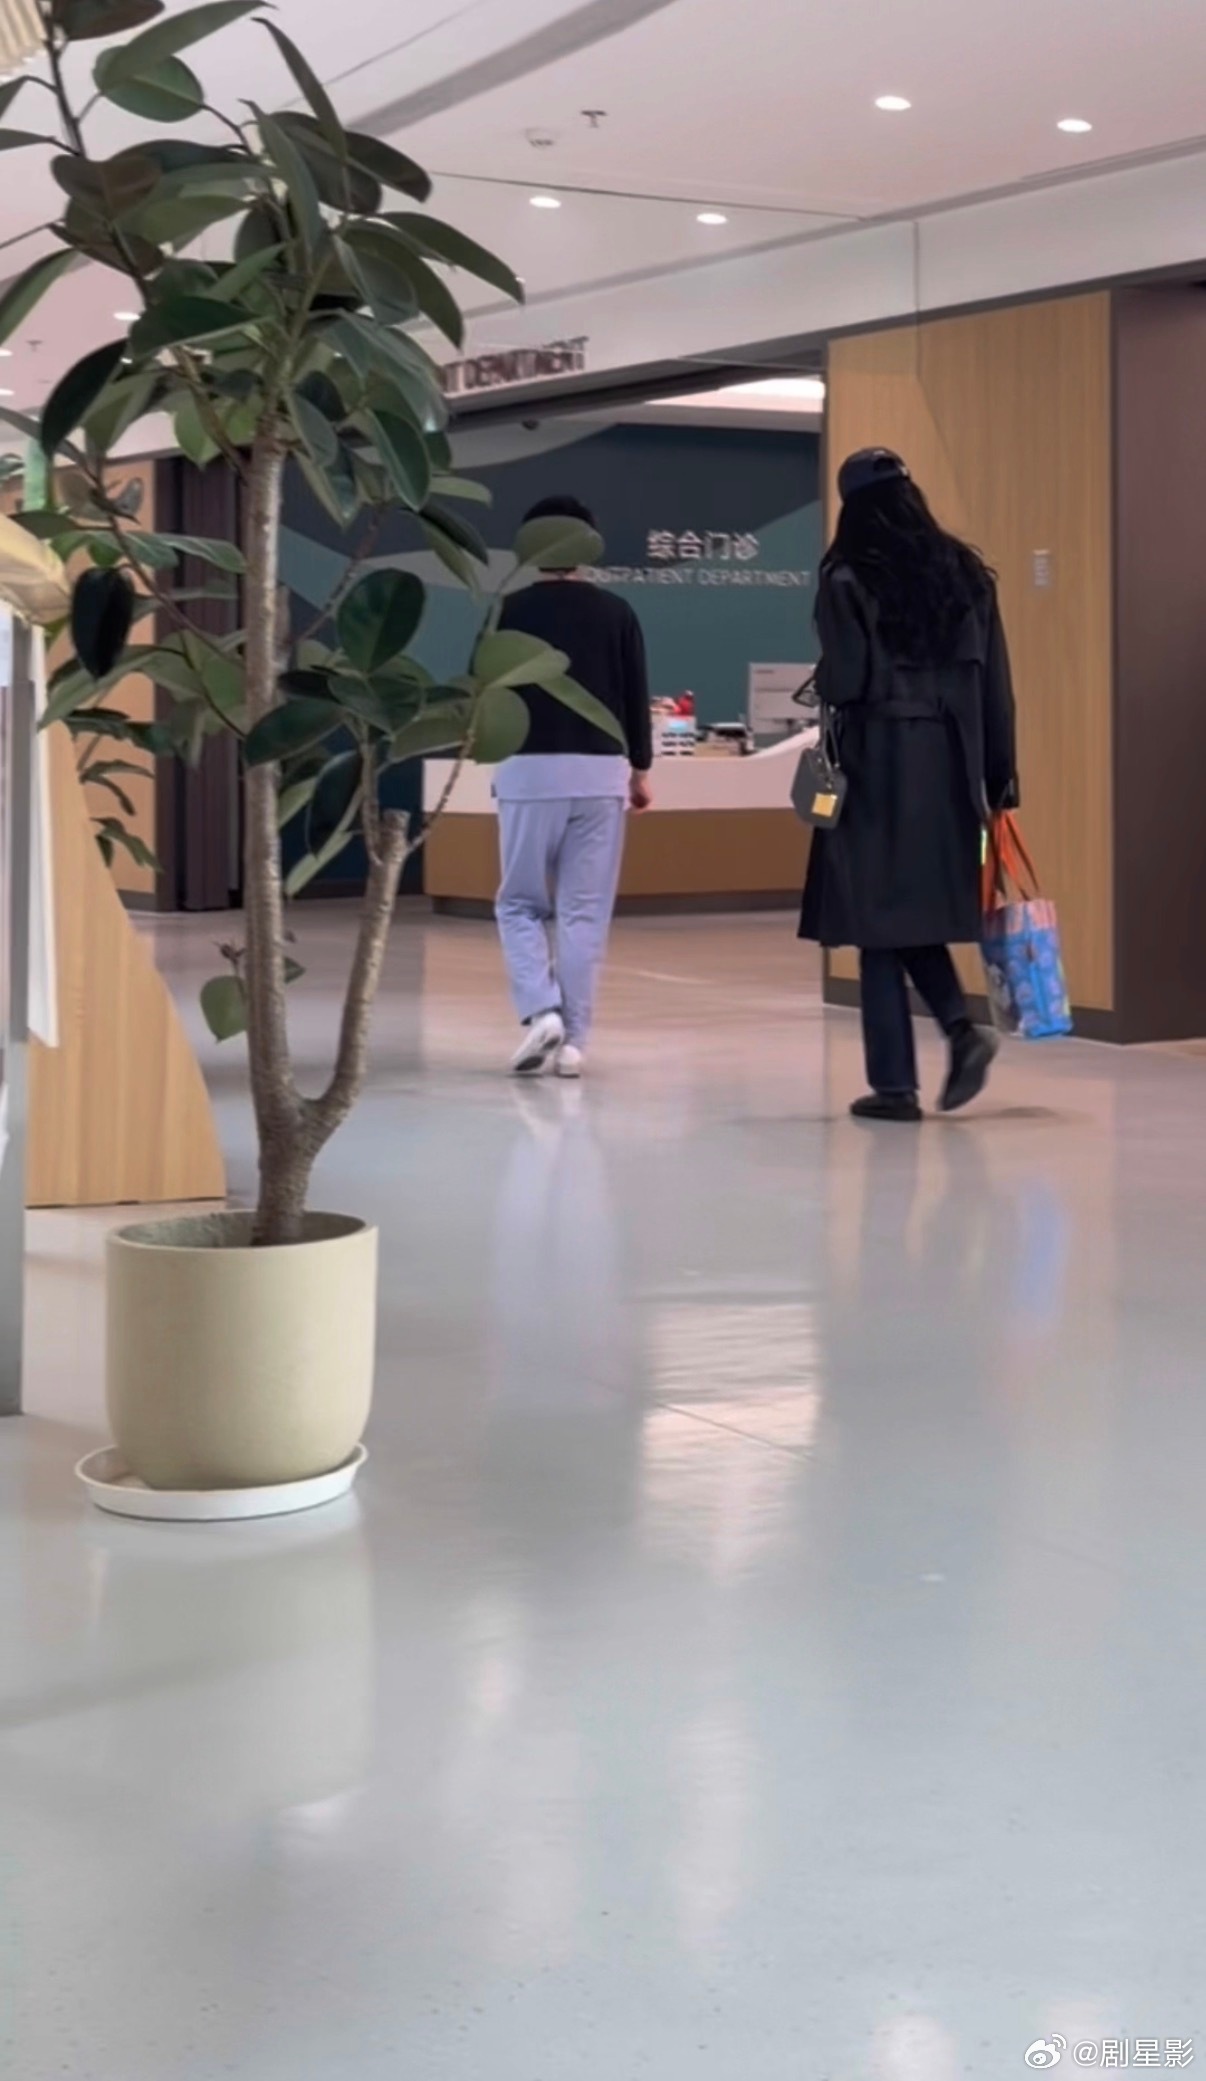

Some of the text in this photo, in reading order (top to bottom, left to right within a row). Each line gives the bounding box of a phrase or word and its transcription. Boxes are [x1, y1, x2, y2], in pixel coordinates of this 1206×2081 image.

[646, 529, 760, 561] 综合门诊
[698, 569, 811, 587] DEPARTMENT
